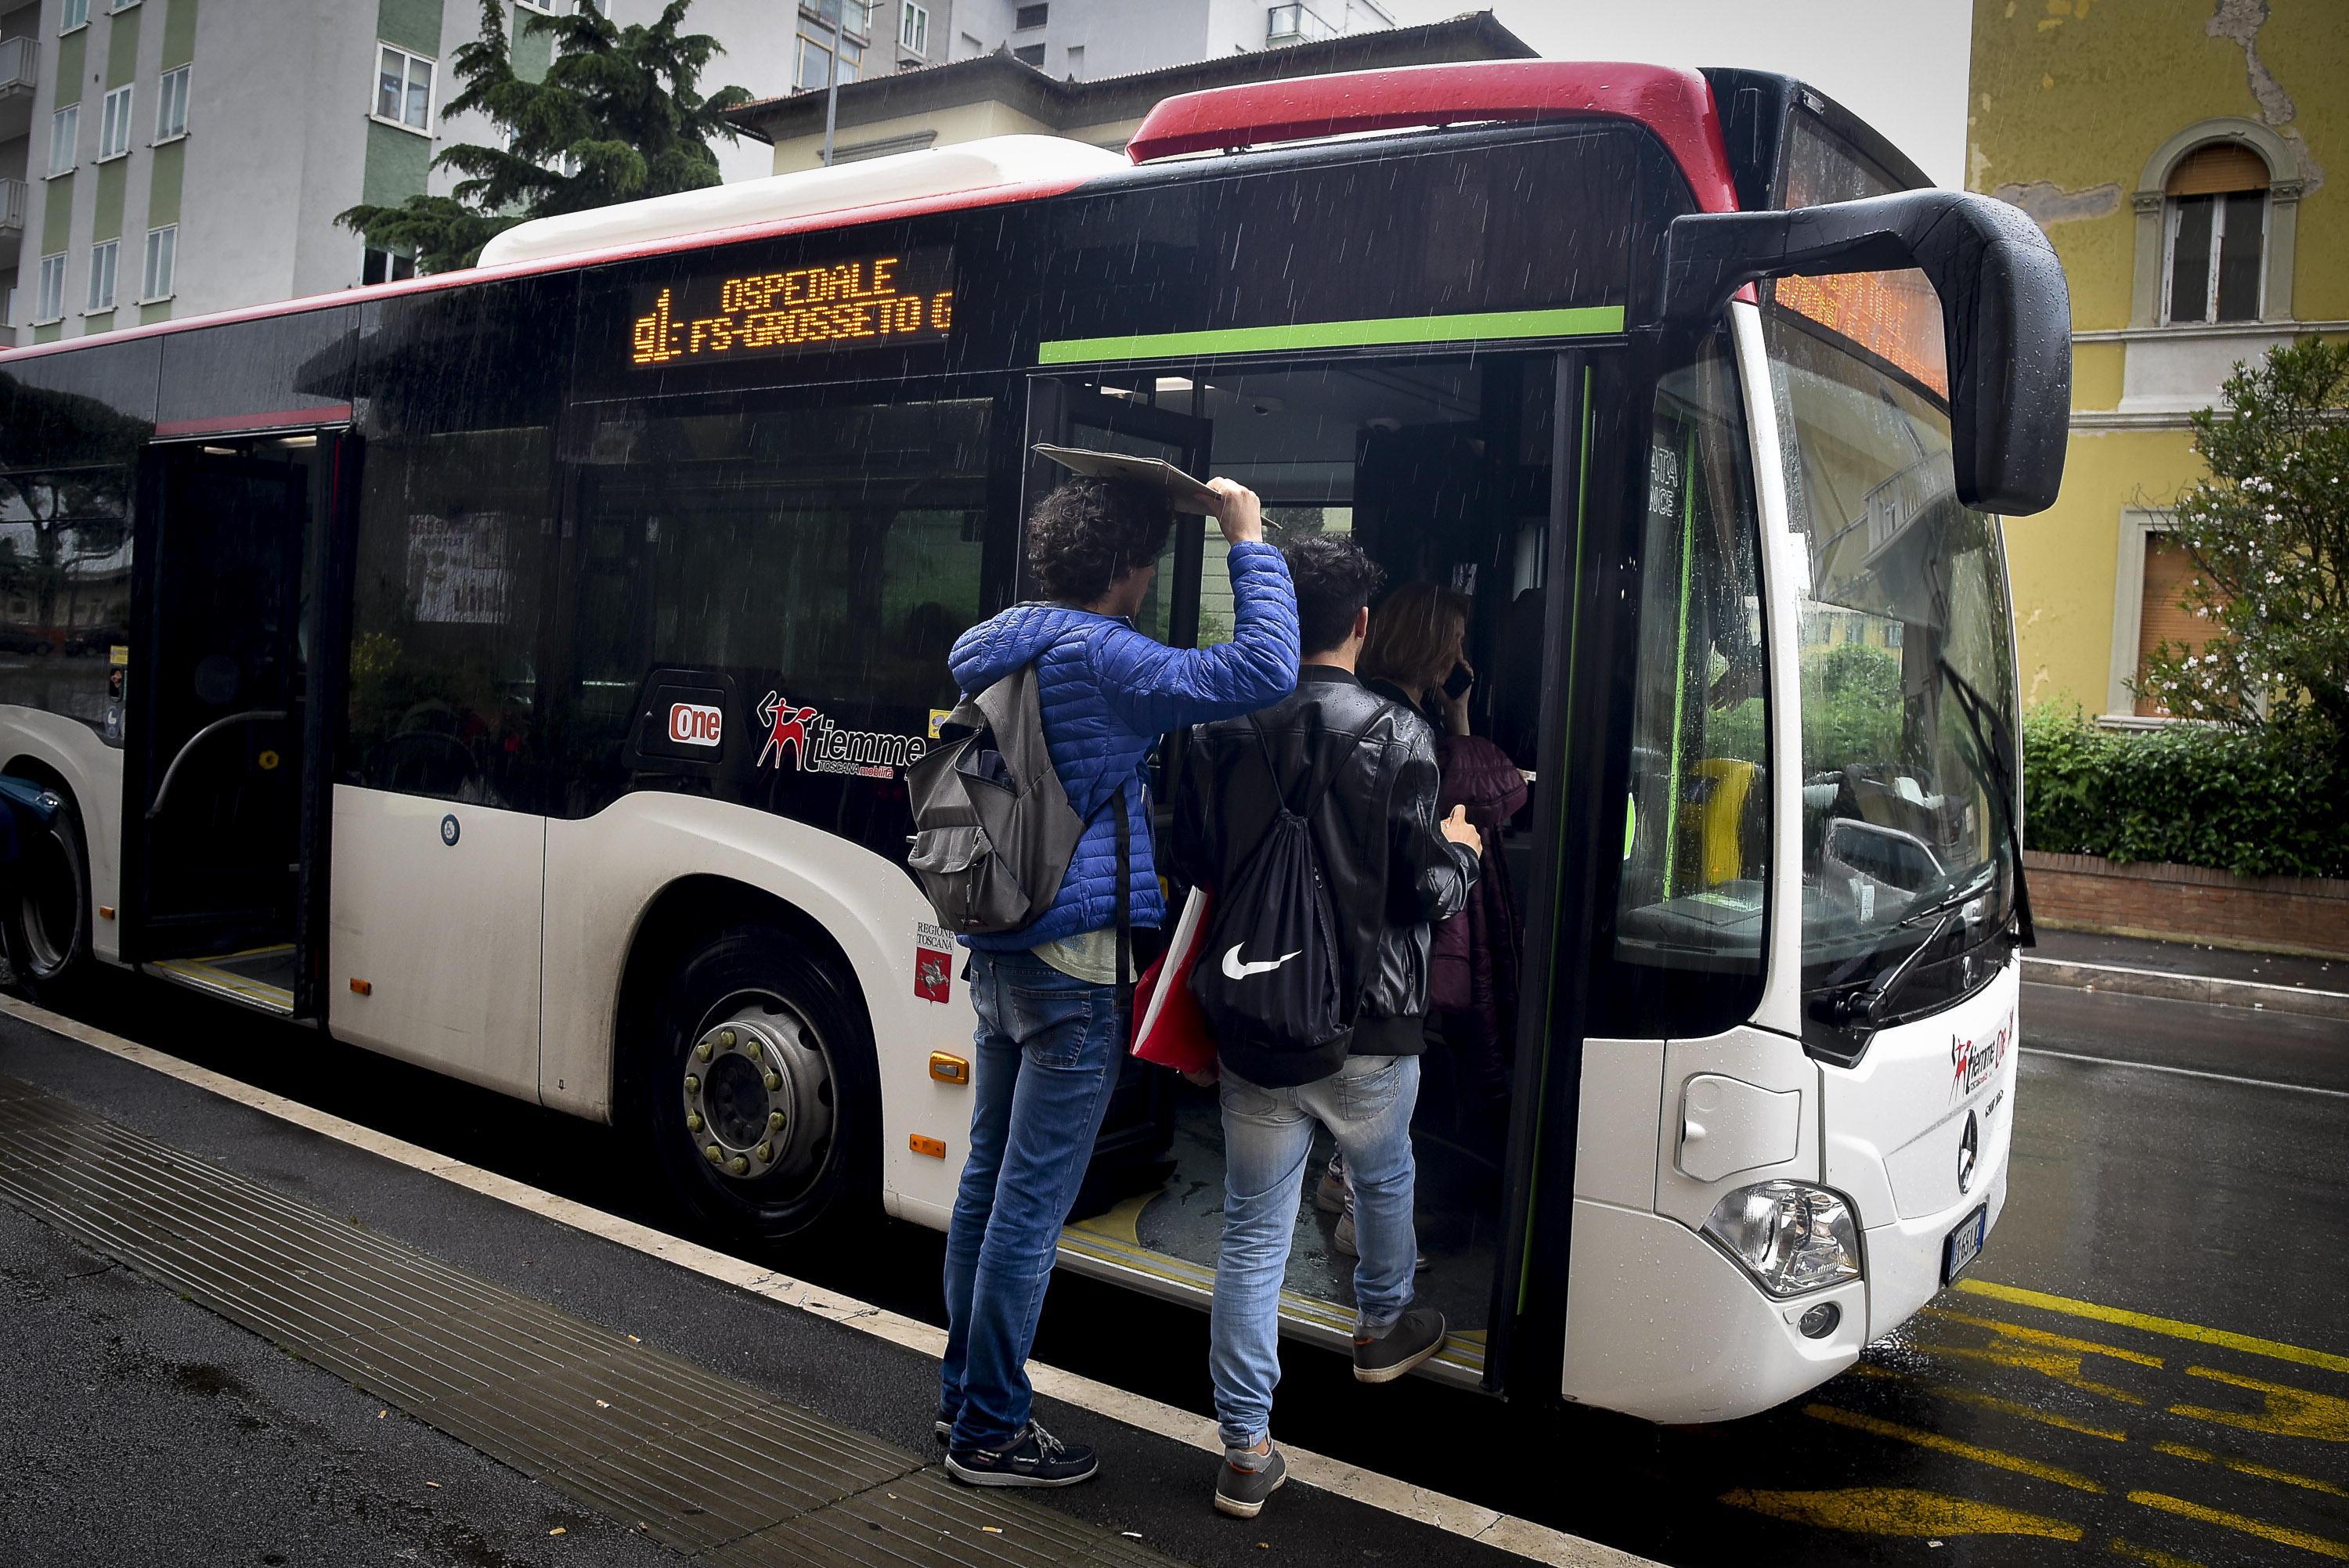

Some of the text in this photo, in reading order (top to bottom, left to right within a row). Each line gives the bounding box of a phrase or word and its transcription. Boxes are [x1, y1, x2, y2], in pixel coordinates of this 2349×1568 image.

[723, 258, 897, 312] OSPEDALE
[670, 705, 720, 741] One
[804, 713, 926, 773] tiemme
[917, 933, 953, 950] TOSCANA
[918, 921, 954, 939] REGIONE
